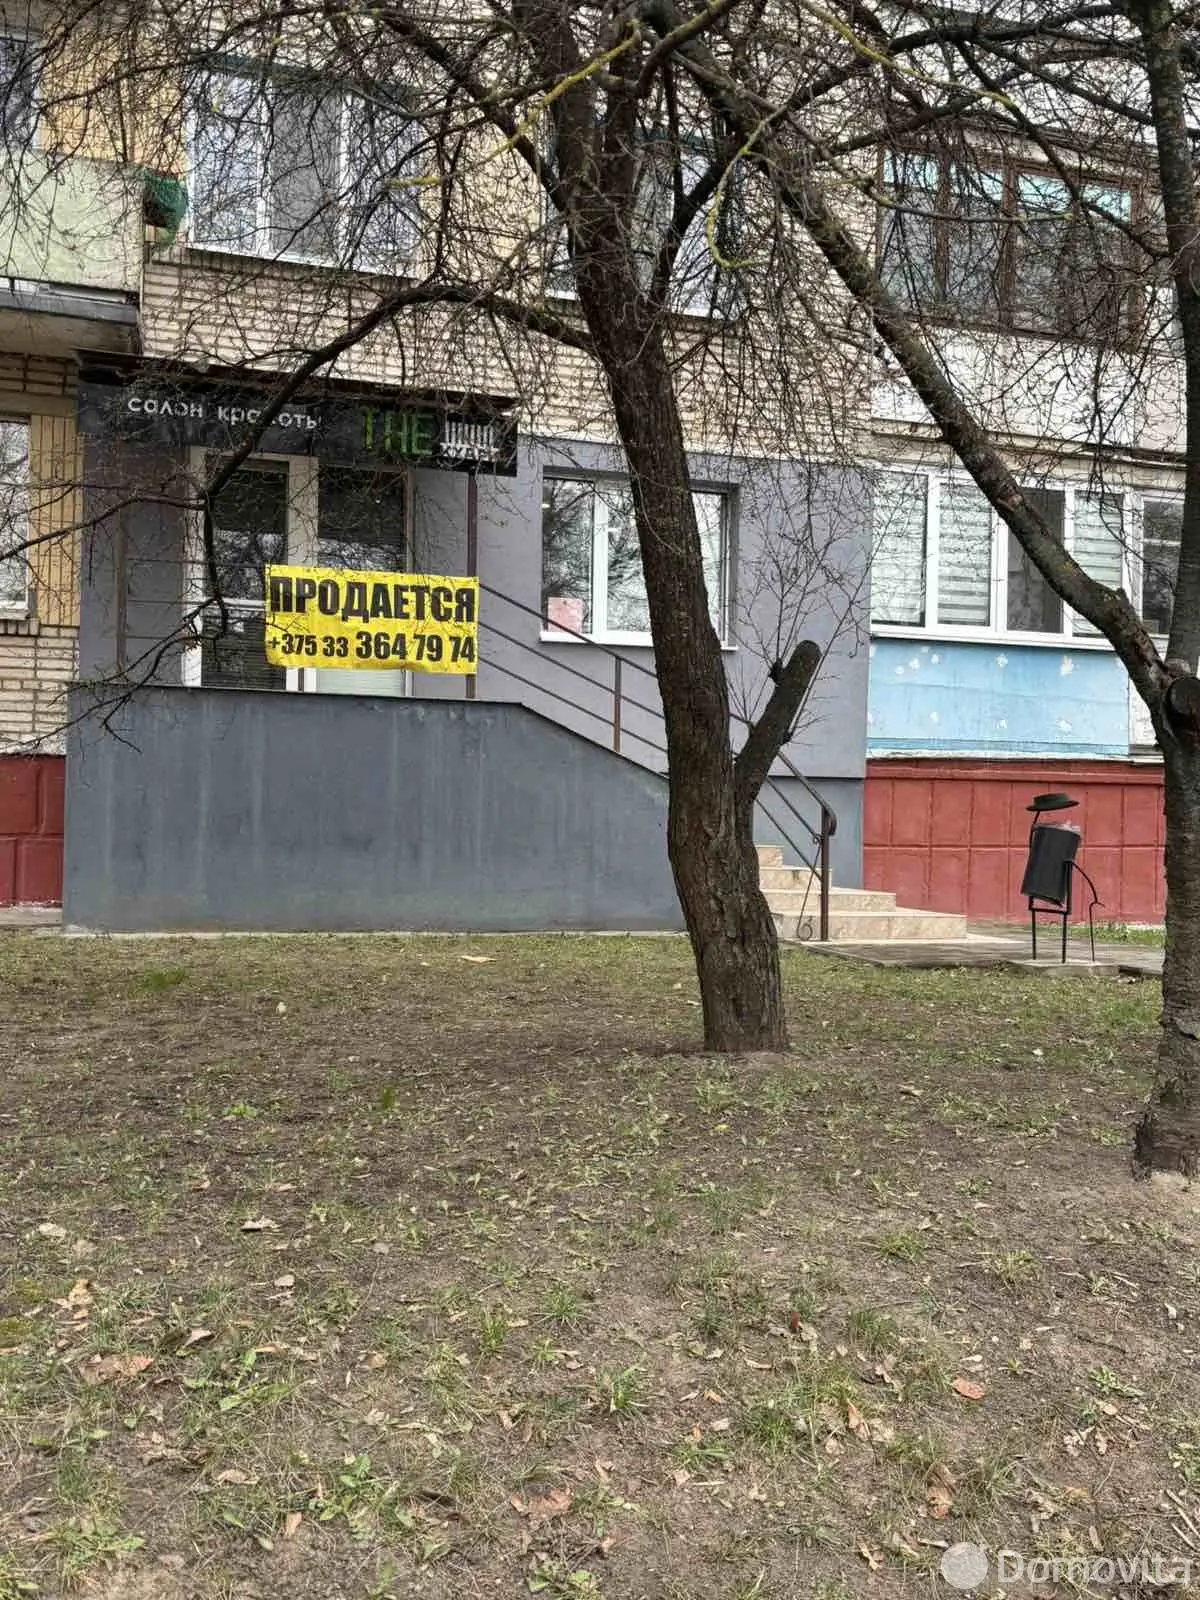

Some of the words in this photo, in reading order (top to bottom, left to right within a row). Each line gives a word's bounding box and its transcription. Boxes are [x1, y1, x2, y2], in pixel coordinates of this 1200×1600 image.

[127, 398, 203, 418] салон
[218, 406, 322, 429] краоты
[361, 407, 433, 456] THE
[270, 576, 475, 623] ПРОДАЕТСЯ
[269, 633, 317, 656] +375
[323, 636, 349, 657] 33
[356, 631, 408, 660] 364
[414, 633, 442, 662] 79
[449, 635, 475, 663] 74
